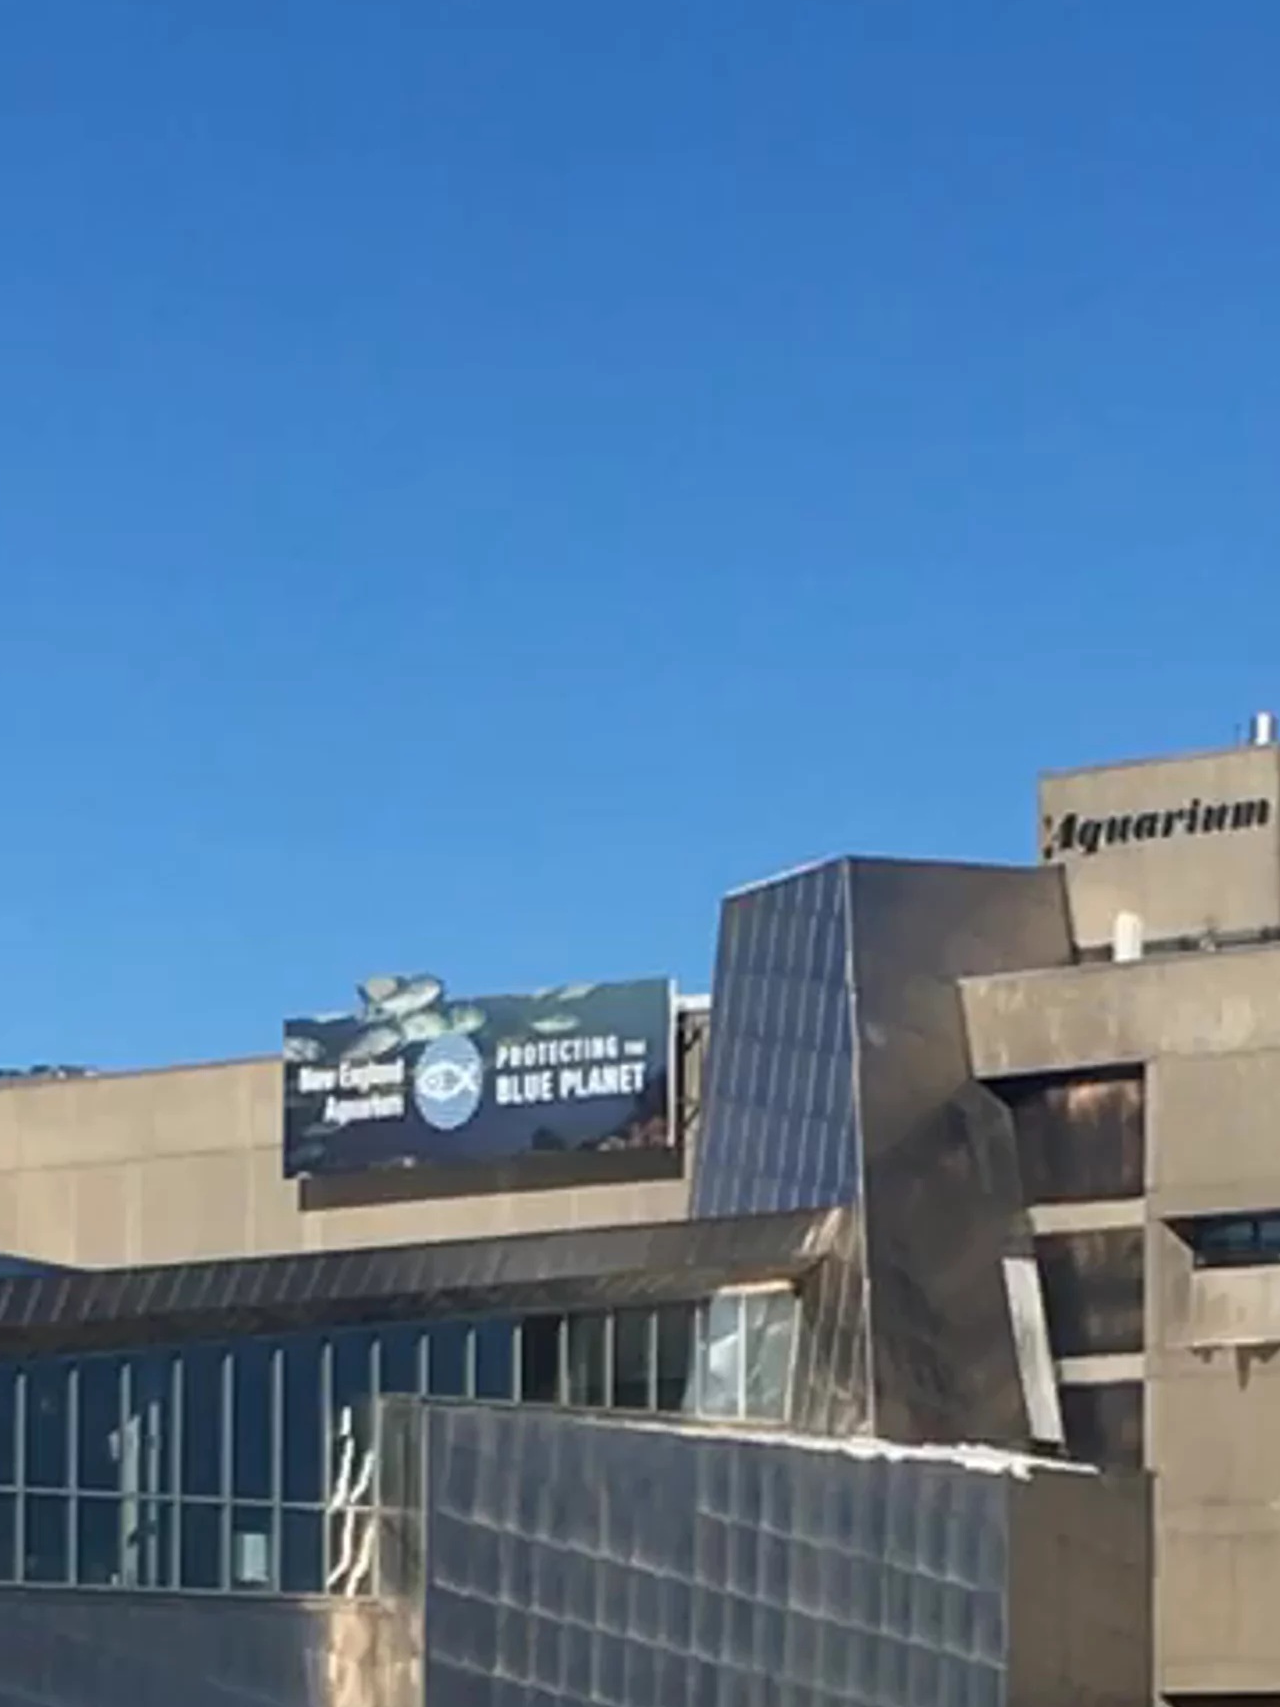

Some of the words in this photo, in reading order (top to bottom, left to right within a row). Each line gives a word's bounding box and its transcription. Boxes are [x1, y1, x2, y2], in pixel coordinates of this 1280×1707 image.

[1052, 797, 1270, 855] Aquarium
[496, 1035, 618, 1069] PROTECTING
[496, 1071, 554, 1105] BLUE
[560, 1061, 645, 1099] PLANET
